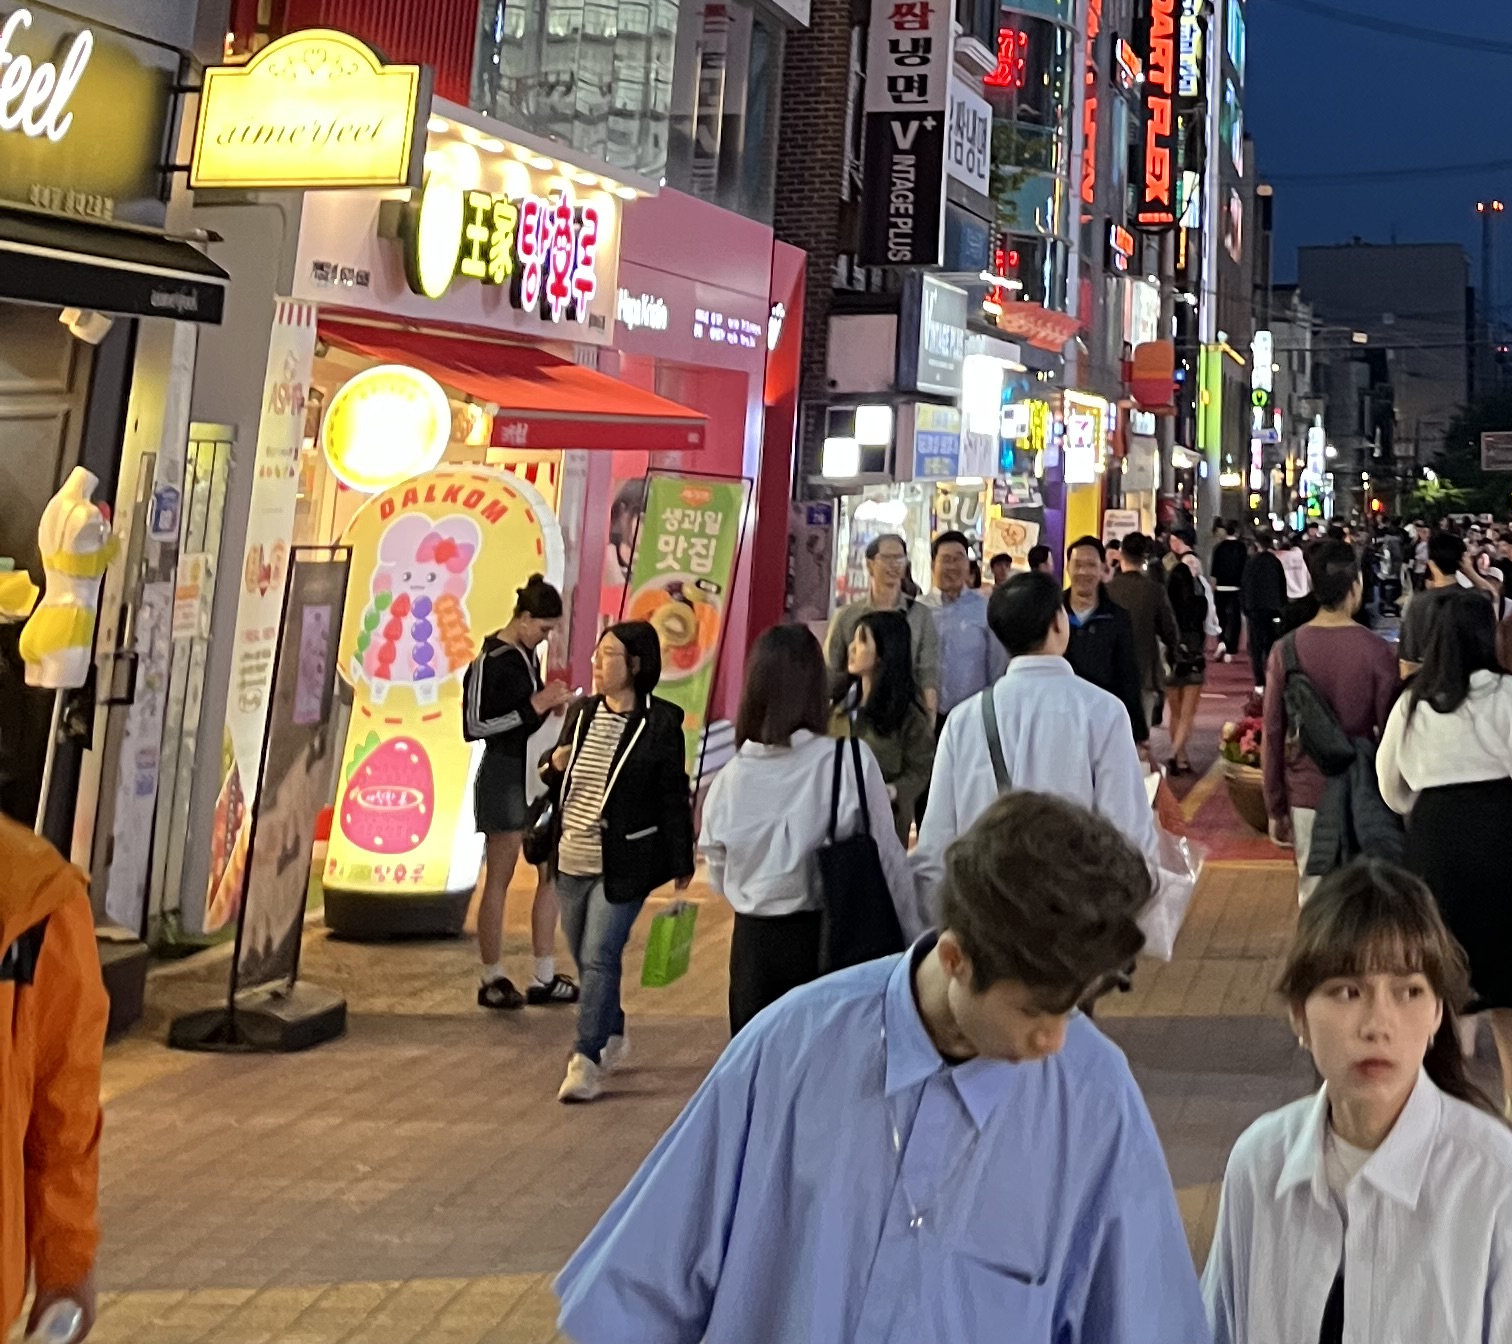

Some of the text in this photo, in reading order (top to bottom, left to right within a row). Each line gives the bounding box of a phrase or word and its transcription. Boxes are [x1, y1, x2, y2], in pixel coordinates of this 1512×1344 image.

[216, 115, 384, 150] aimerfeel
[1146, 95, 1172, 206] FLEX
[461, 190, 517, 285] 王家
[887, 214, 912, 263] PLUS
[380, 483, 509, 525] DALKOM
[661, 507, 722, 535] 생과일
[656, 534, 717, 573] 맛집
